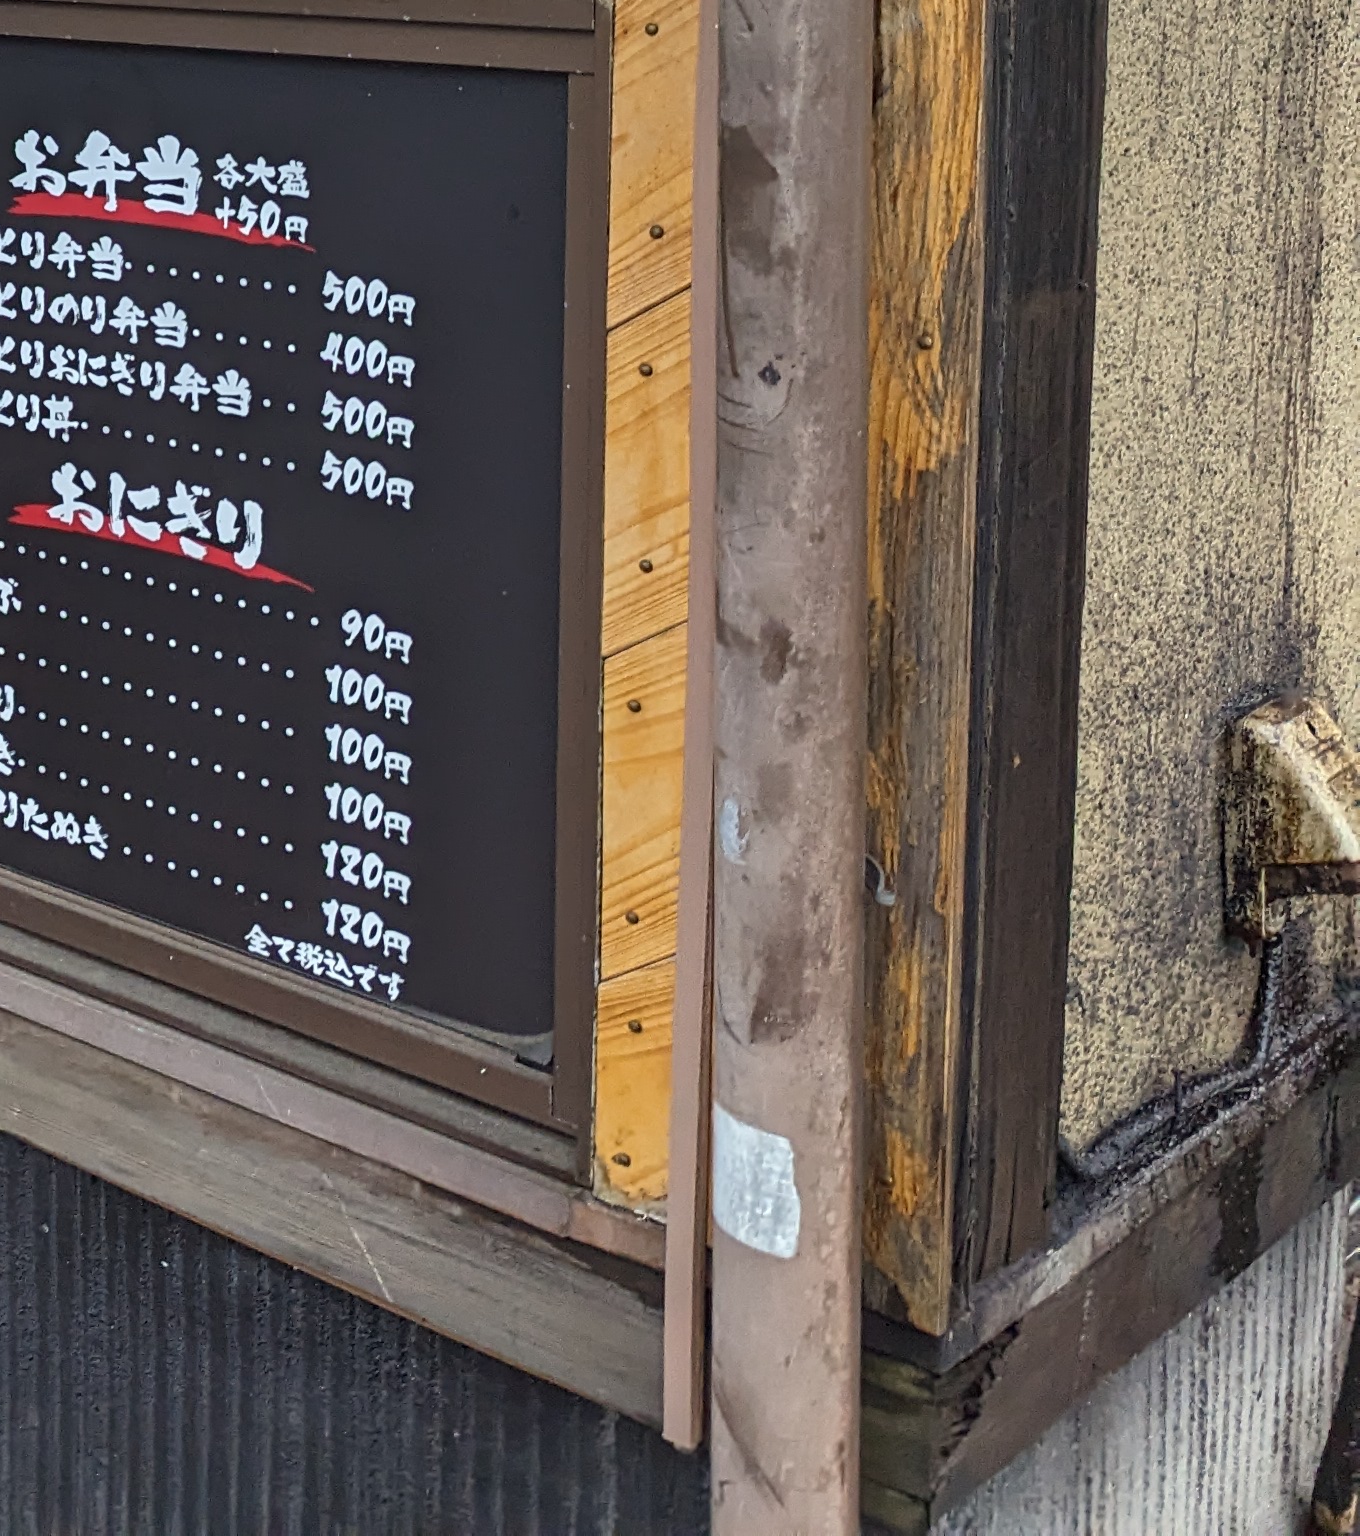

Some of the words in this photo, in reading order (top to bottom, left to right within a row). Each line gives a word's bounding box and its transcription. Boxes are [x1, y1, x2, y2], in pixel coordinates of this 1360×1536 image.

[9, 129, 202, 215] お弁当
[213, 152, 311, 199] 各大盛
[321, 270, 416, 327] 500円
[320, 331, 416, 388] 400円
[321, 389, 415, 449] 500円
[320, 449, 414, 511] 500円
[46, 462, 264, 570] おにぎり
[341, 609, 413, 664] 90円
[325, 664, 413, 724] 100円
[325, 724, 413, 786] 100円
[325, 782, 412, 846] 100円
[321, 840, 412, 904] 120円
[321, 898, 411, 965] 120円
[244, 924, 405, 1002] 全て税込です
